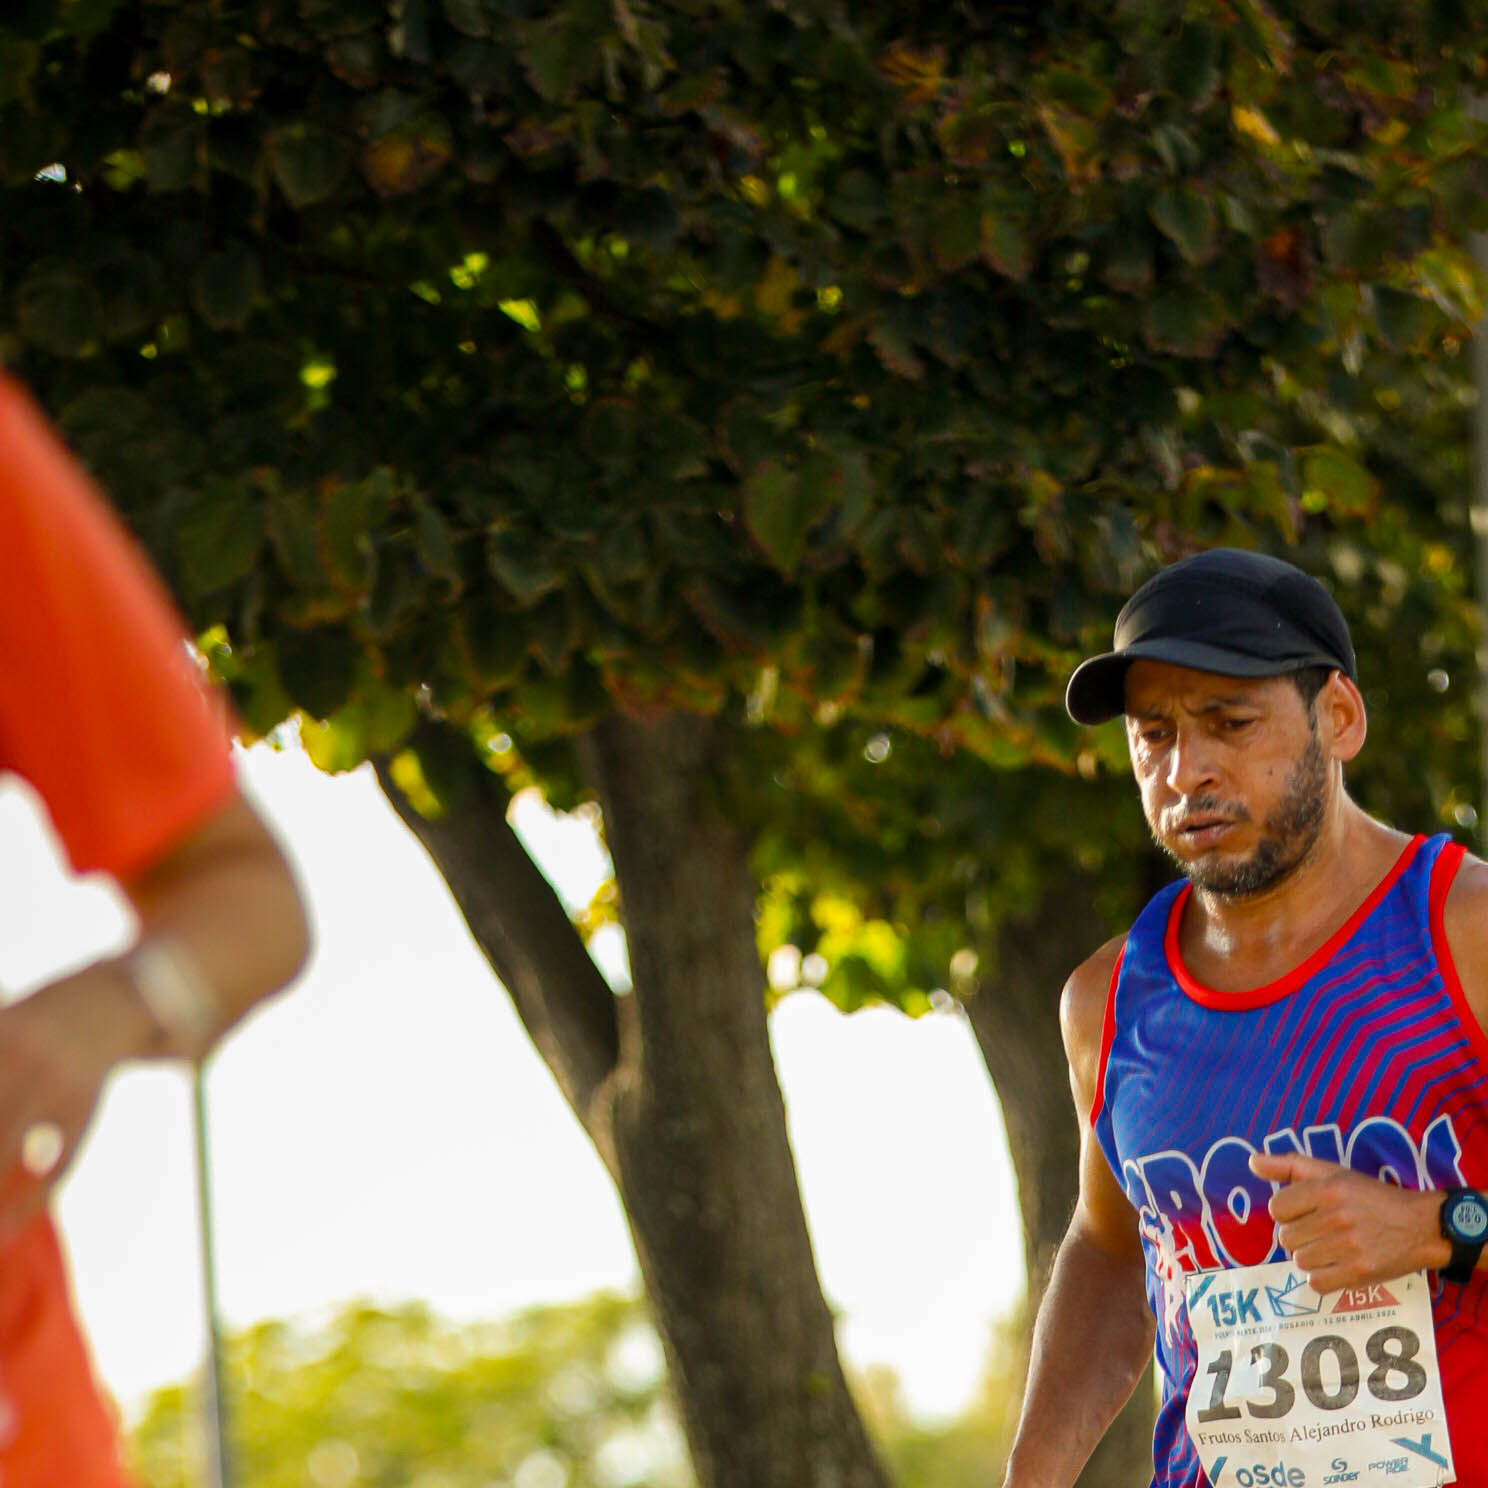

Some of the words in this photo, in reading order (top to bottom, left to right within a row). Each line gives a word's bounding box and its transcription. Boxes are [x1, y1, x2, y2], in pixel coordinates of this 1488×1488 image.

[1207, 1288, 1263, 1327] 15K
[1345, 1284, 1385, 1307] 15K
[1197, 1325, 1428, 1424] 1308
[1198, 1431, 1242, 1446] Frutos
[1244, 1428, 1287, 1444] Santos
[1289, 1416, 1367, 1443] Alejandro
[1370, 1408, 1435, 1429] Rodrigo
